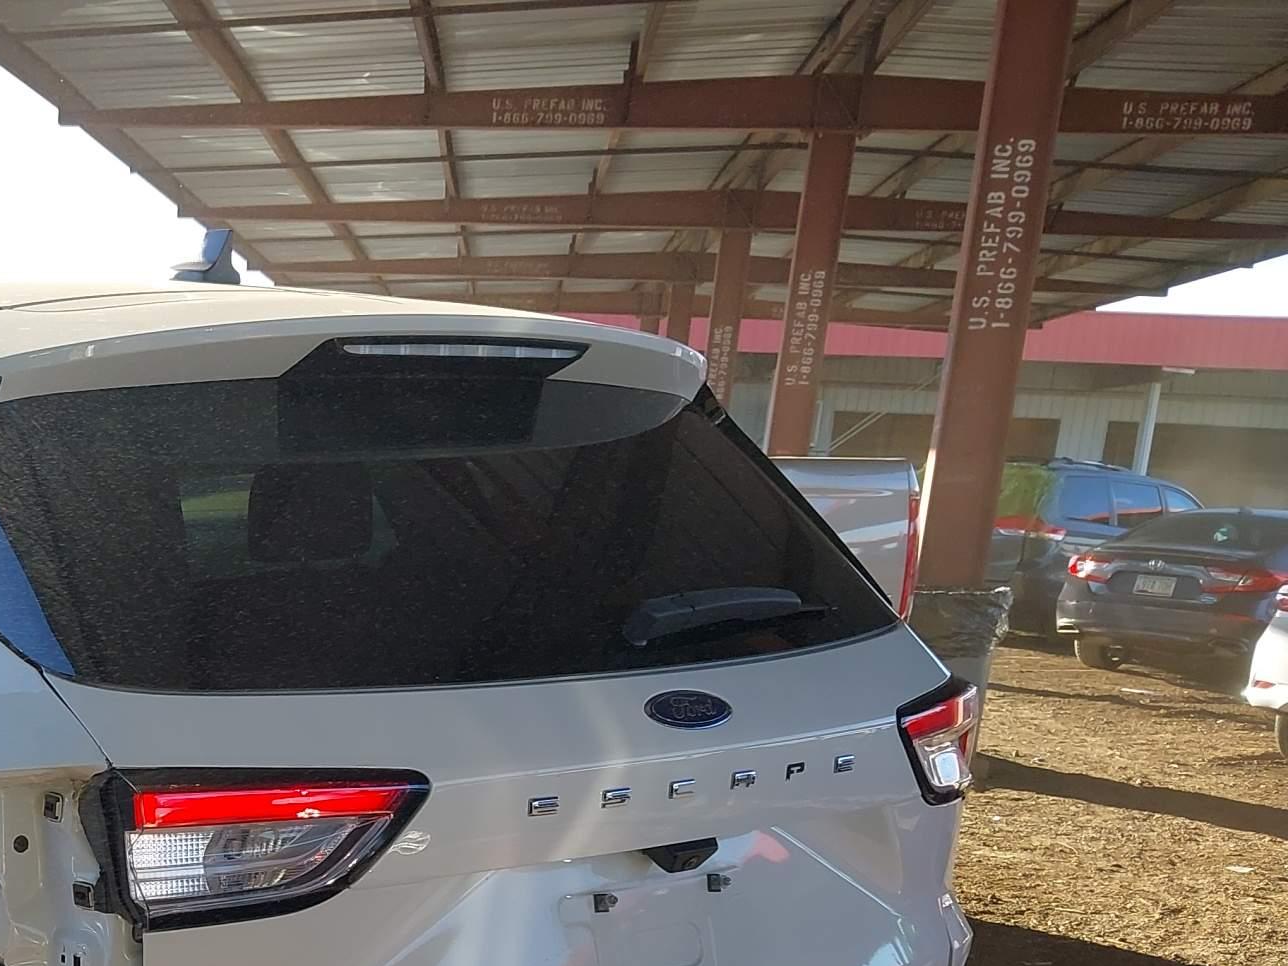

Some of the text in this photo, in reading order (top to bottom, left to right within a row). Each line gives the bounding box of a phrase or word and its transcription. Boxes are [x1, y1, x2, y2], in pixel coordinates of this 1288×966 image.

[1160, 102, 1219, 115] PREFAB
[968, 137, 1015, 330] U.S. PREFAB INC.
[991, 138, 1037, 328] 1-866-799-0969
[527, 753, 856, 817] ESCAPE
